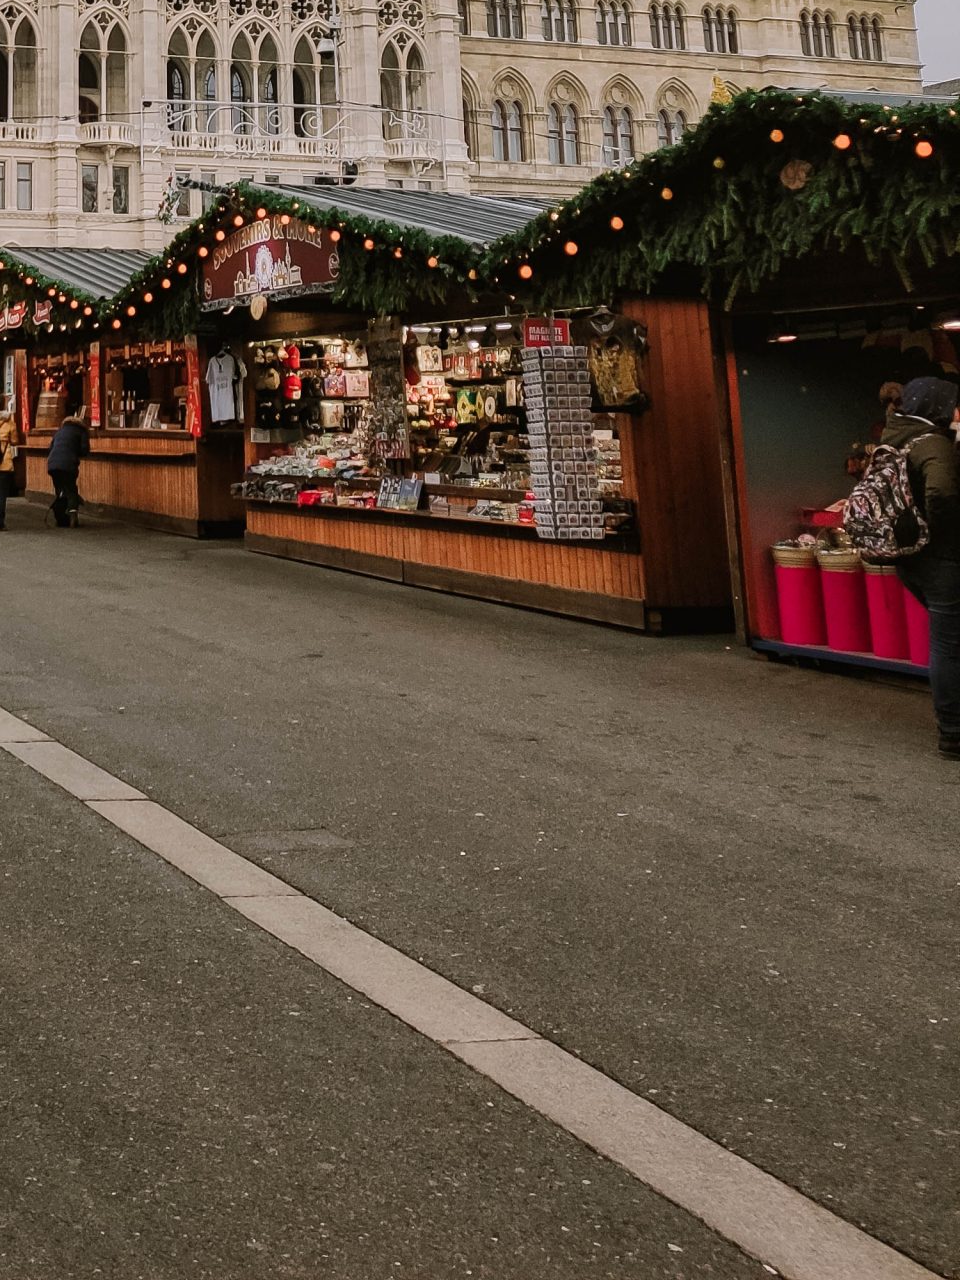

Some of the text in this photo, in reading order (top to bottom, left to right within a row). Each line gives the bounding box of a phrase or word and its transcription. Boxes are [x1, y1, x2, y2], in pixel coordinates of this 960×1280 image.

[213, 214, 322, 270] SOUVENIRS & MORE
[528, 326, 563, 335] MAGNTE
